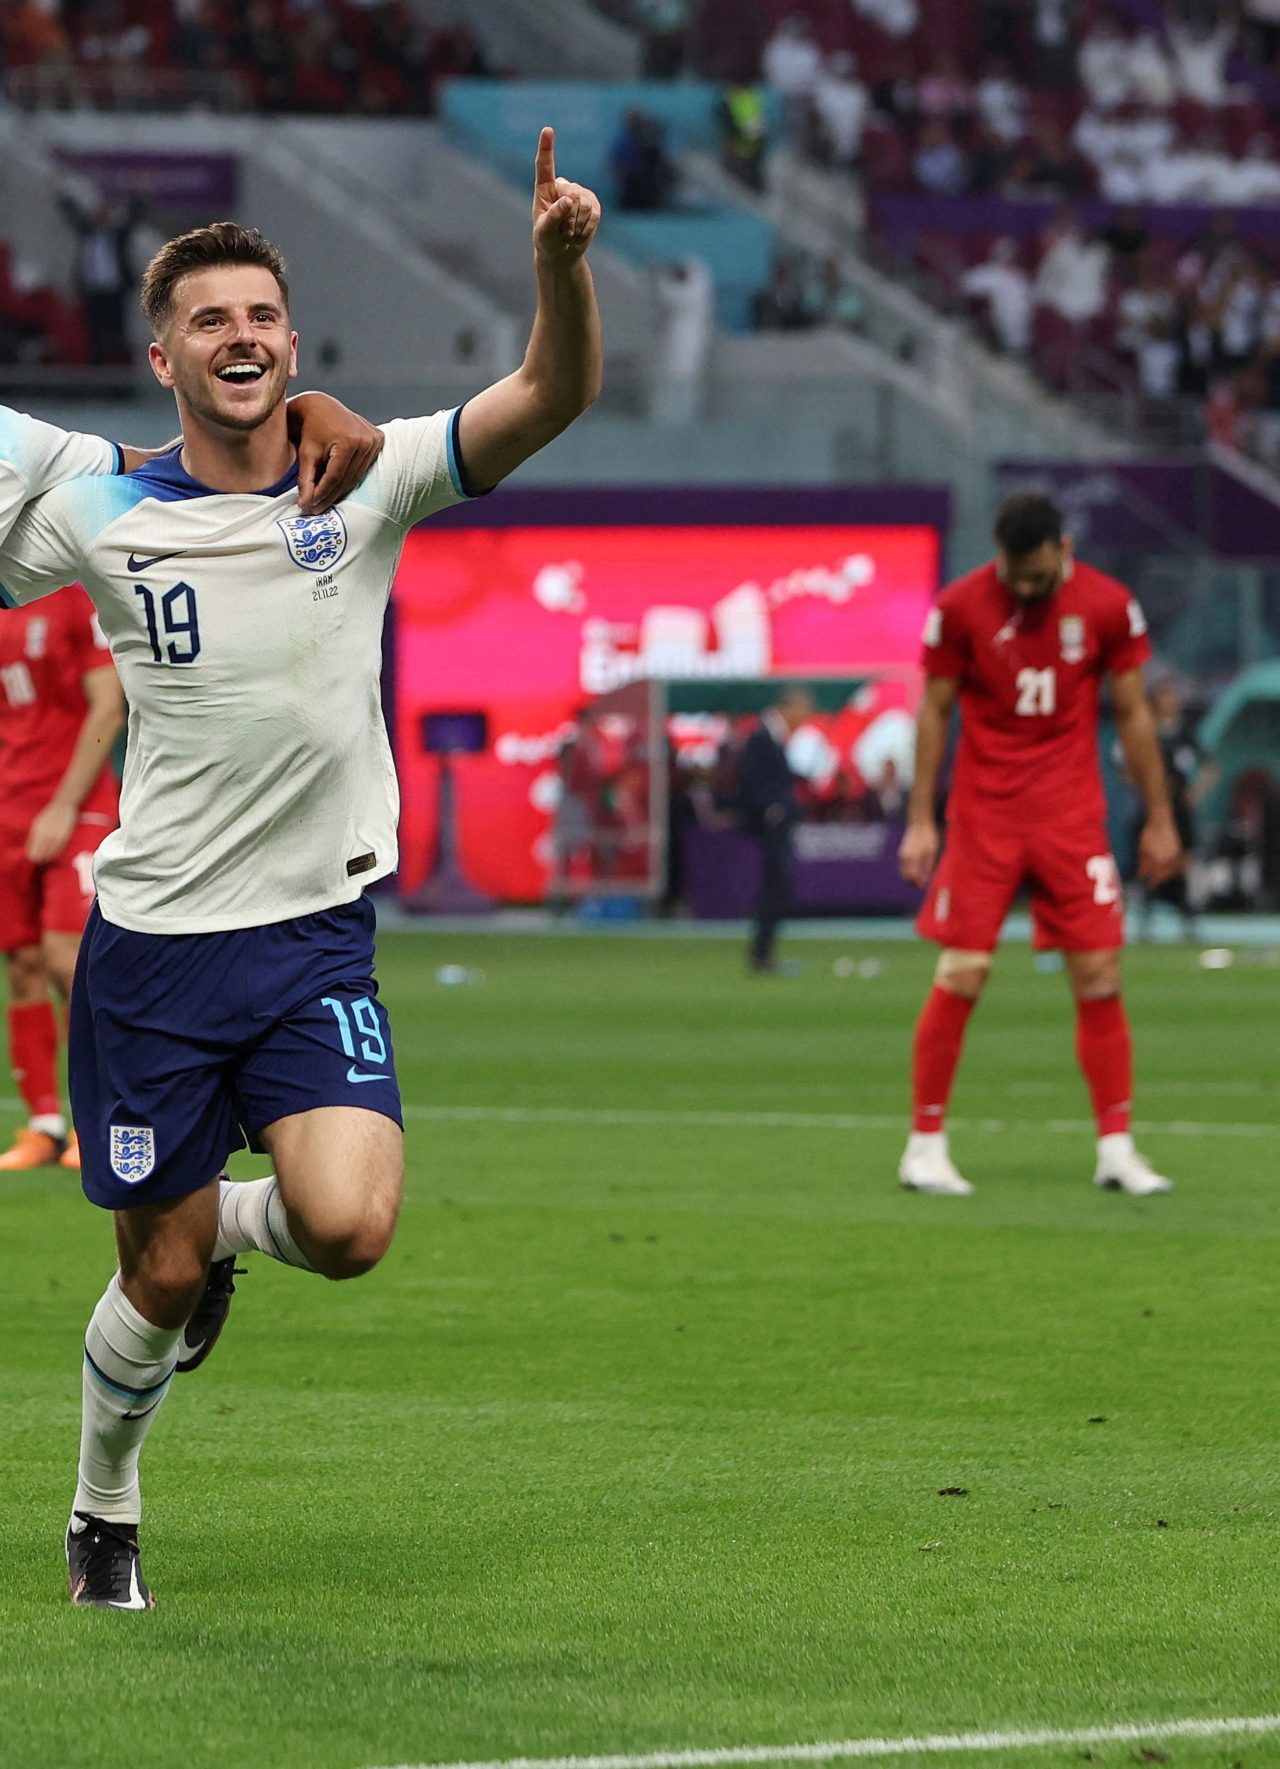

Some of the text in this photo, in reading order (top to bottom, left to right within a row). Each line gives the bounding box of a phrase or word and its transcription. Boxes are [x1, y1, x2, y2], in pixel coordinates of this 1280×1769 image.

[133, 581, 201, 664] 19
[1015, 666, 1056, 717] 21
[320, 996, 387, 1064] 19
